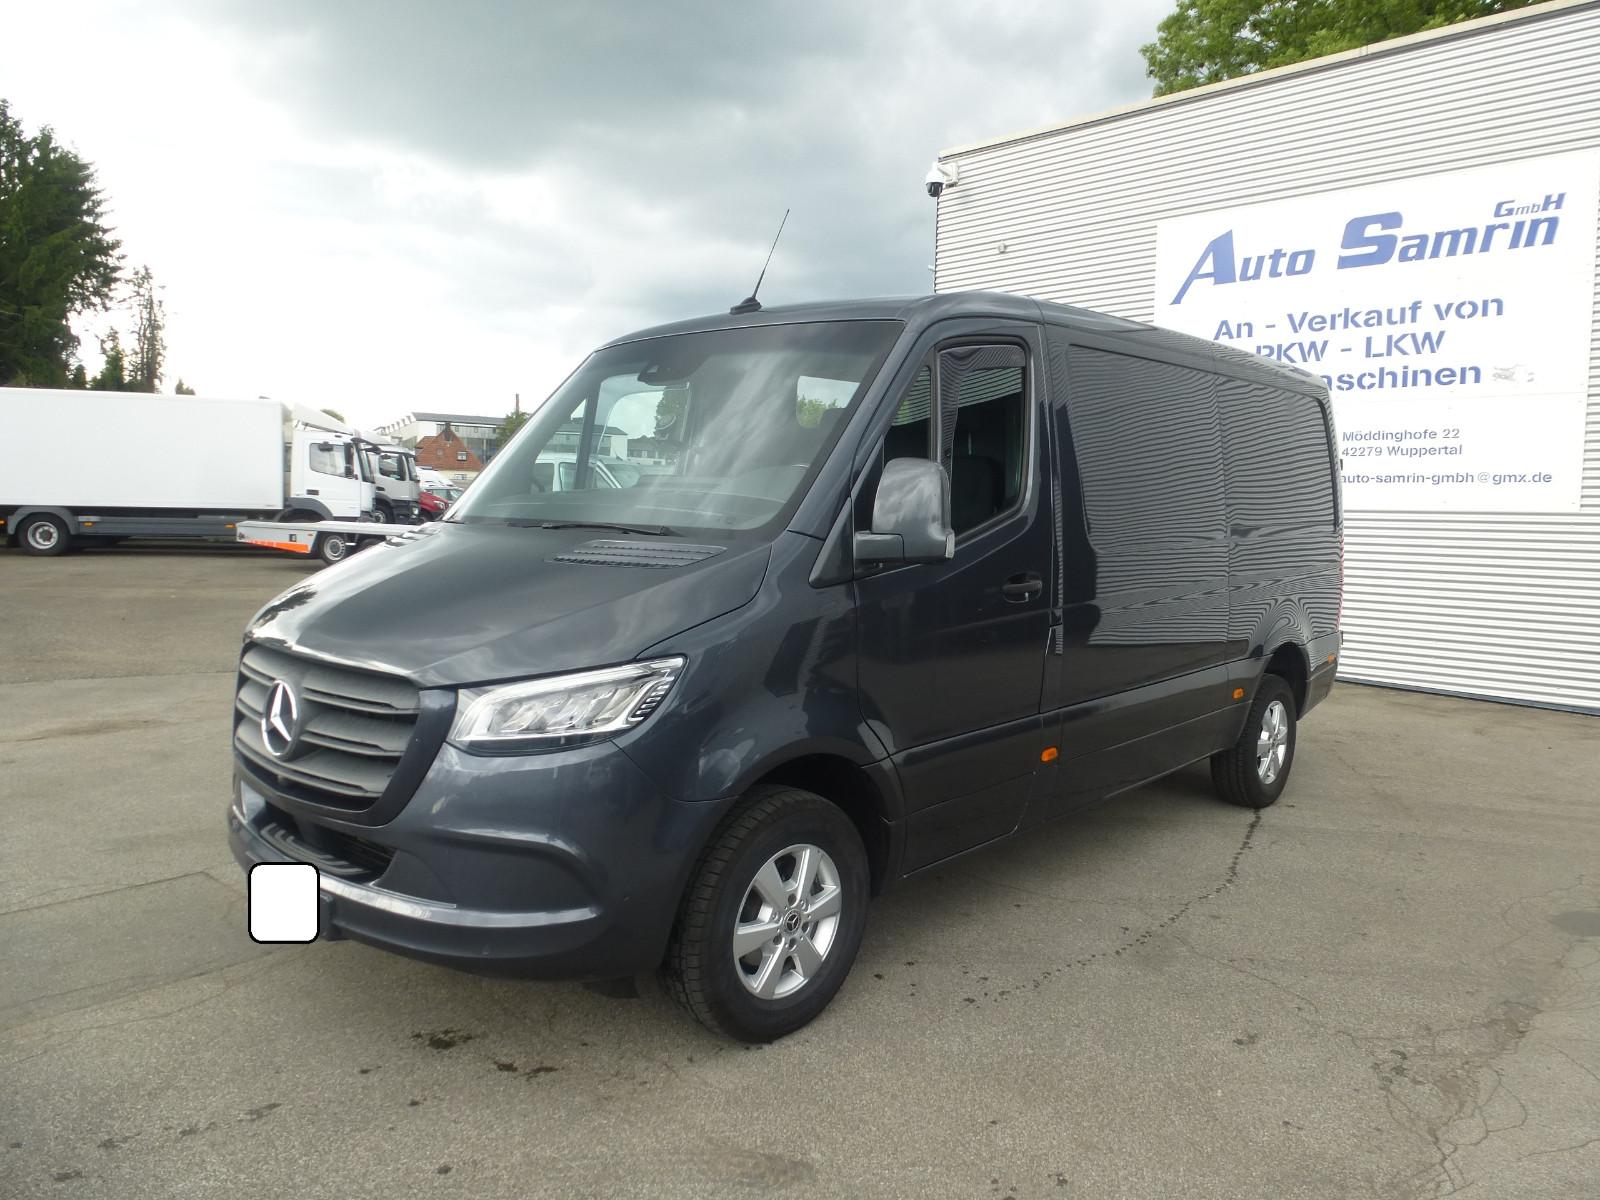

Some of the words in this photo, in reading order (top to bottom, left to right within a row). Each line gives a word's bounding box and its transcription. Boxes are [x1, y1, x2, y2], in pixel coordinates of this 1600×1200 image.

[1169, 229, 1316, 306] Auto
[1337, 211, 1560, 270] Samrin
[1213, 319, 1254, 341] An
[1287, 300, 1422, 334] Verkauf
[1434, 297, 1504, 321] von
[1256, 340, 1329, 364] PKW
[1365, 330, 1446, 359] LKW
[1341, 446, 1383, 457] 42279
[1387, 444, 1463, 458] Wuppertal
[1342, 430, 1438, 443] Möddinghofe
[1442, 428, 1460, 439] 22
